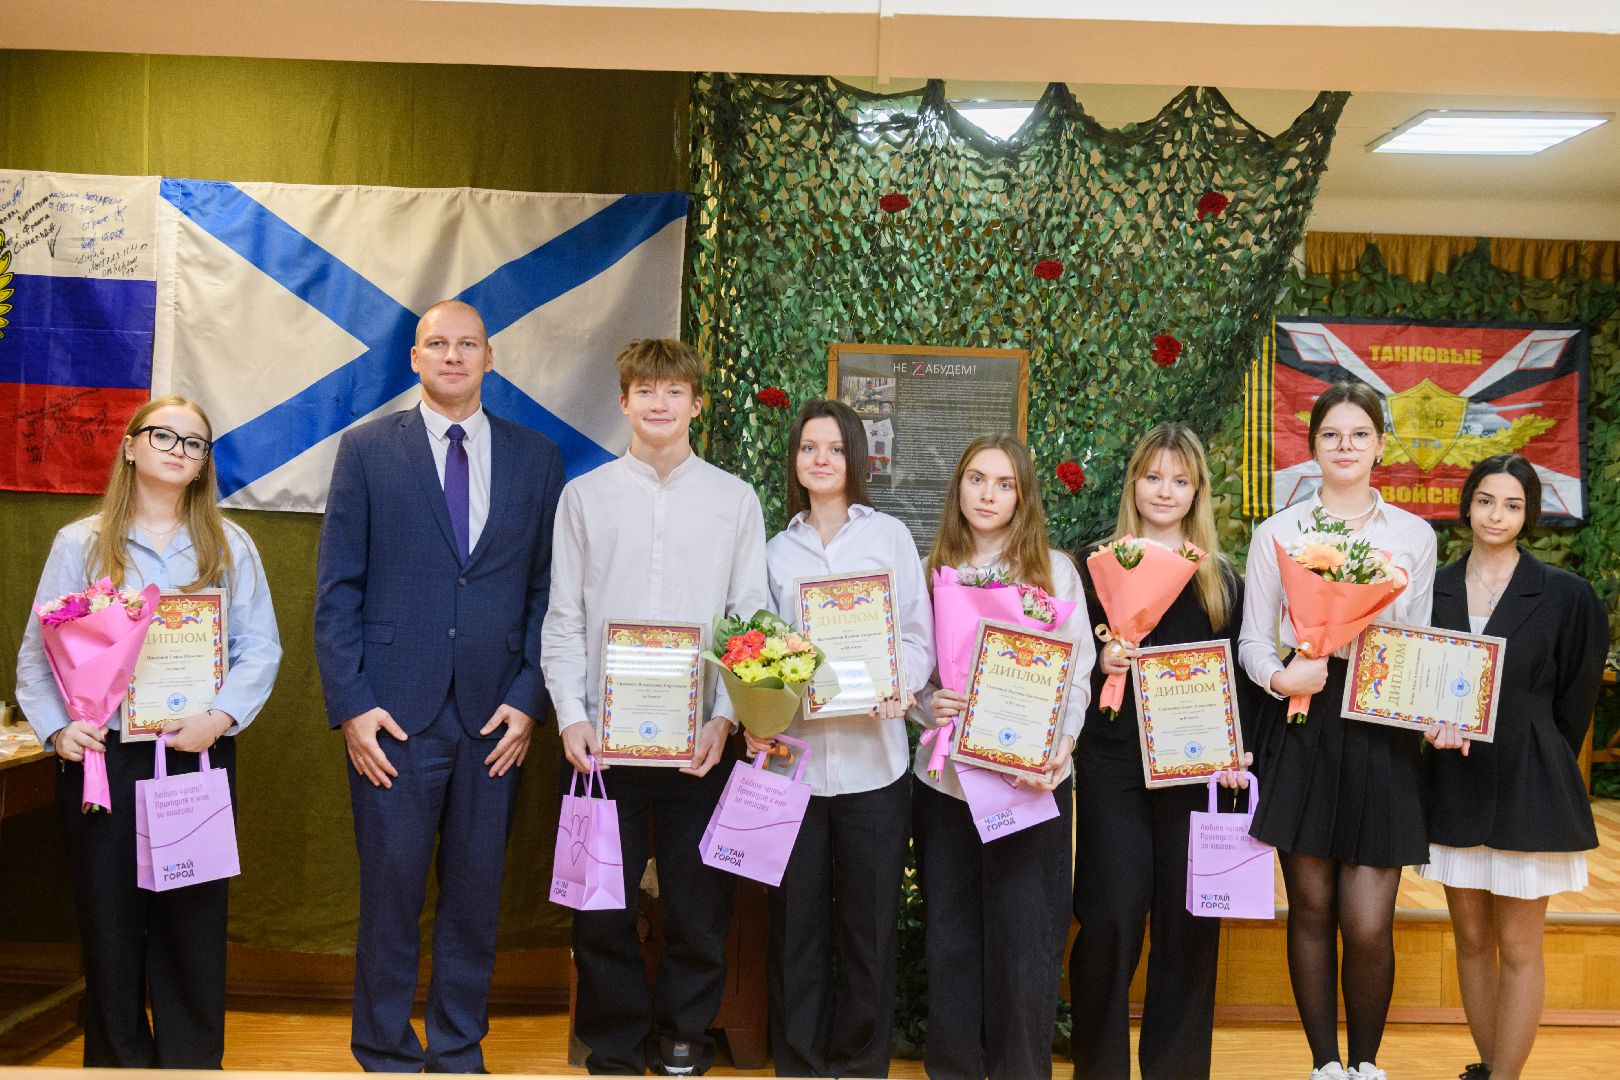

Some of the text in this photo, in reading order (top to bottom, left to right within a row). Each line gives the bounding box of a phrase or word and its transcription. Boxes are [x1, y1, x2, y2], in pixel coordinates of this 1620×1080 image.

[1368, 344, 1482, 366] ТАНКОВЫЕ
[893, 362, 907, 373] НЕ
[1381, 484, 1461, 504] ВОЙСК
[817, 611, 880, 627] ДИПЛОМ
[989, 663, 1052, 687] ДИПЛОМ
[1389, 642, 1408, 706] ДИПЛОМ
[1154, 682, 1216, 698] ДИПЛОМ
[984, 808, 1013, 825] ЧИТАЙ
[987, 817, 1016, 832] ГОРОД
[717, 844, 746, 859] ЧИТАЙ
[163, 860, 194, 873] ЧИТАЙ
[714, 852, 742, 867] ГОРОД
[164, 869, 195, 882] ГОРОД
[1201, 893, 1230, 902] ЧИТАЙ
[1201, 902, 1231, 911] ГОРОД
